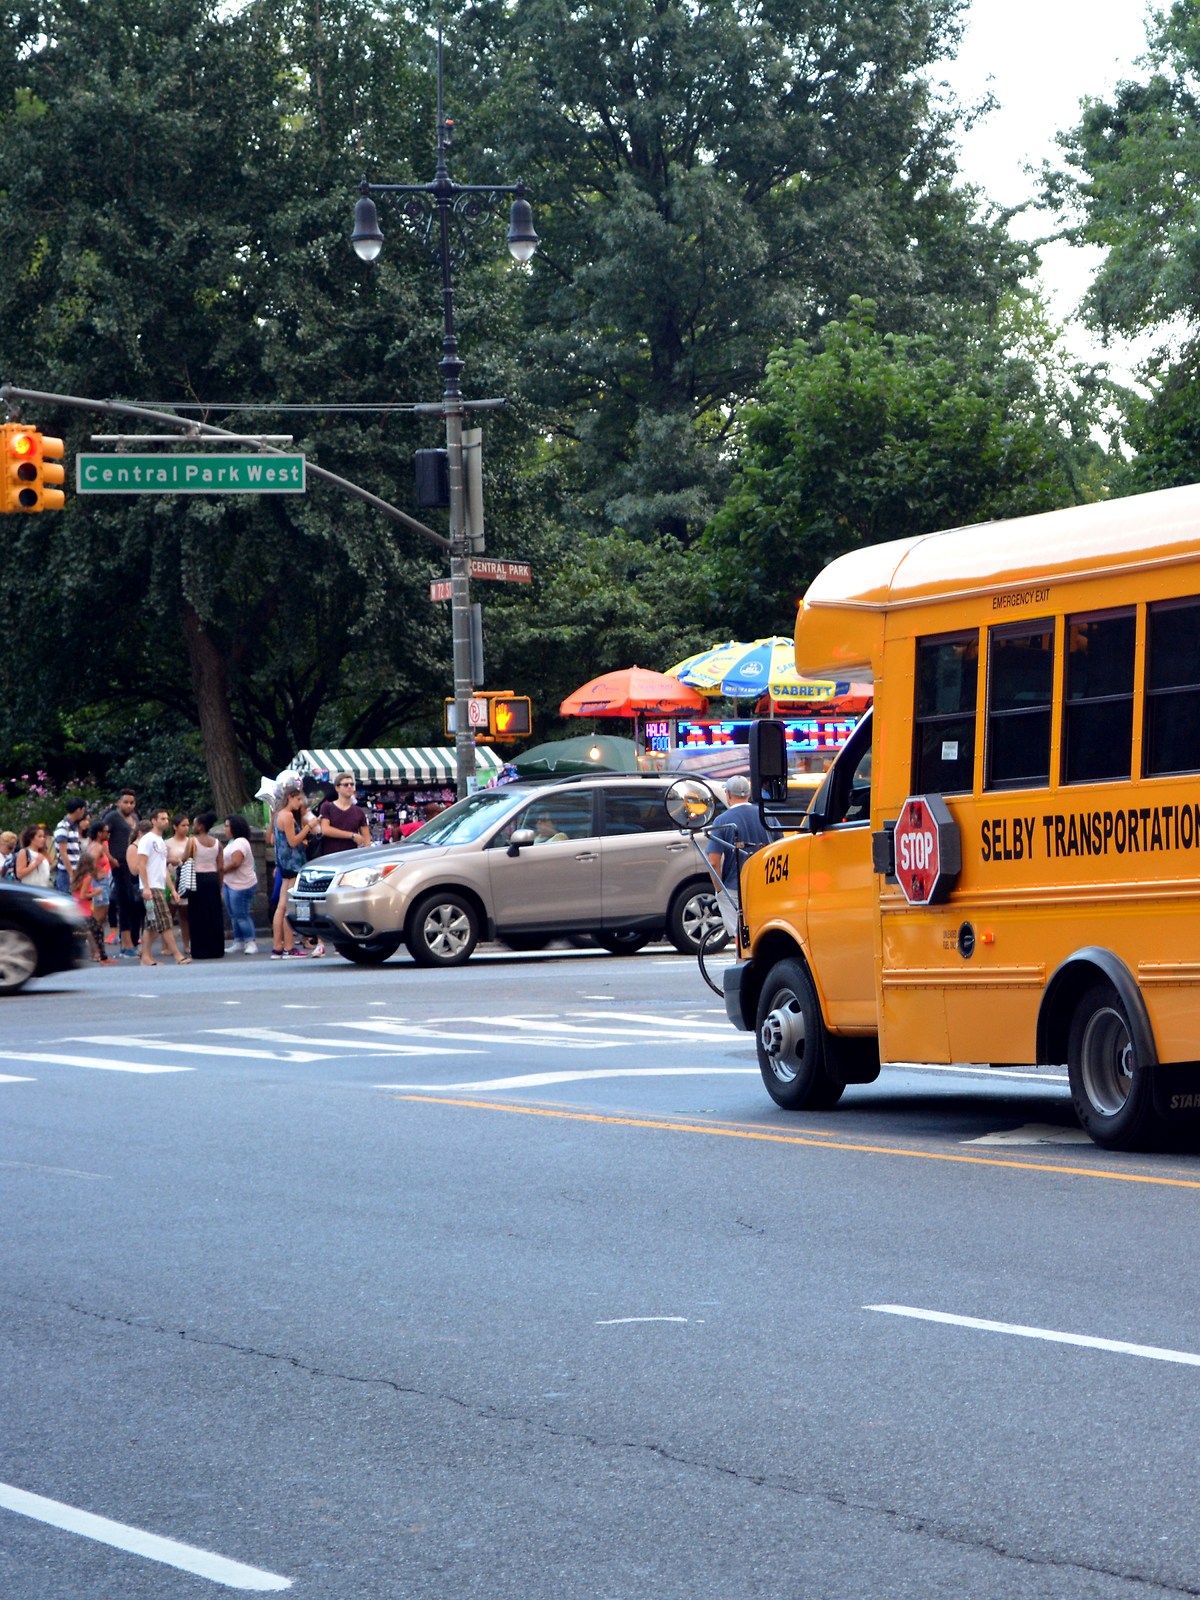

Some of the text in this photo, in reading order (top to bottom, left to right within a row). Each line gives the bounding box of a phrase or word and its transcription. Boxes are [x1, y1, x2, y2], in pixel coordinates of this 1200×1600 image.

[84, 465, 299, 482] Central Park West
[472, 561, 529, 576] CENTRAL PARK
[992, 588, 1050, 610] EMERGENCY EXIT
[772, 684, 833, 697] SABRETT
[646, 722, 670, 737] HALAL
[981, 817, 1036, 862] SELBY
[900, 832, 933, 870] STOP
[764, 854, 789, 884] 1254
